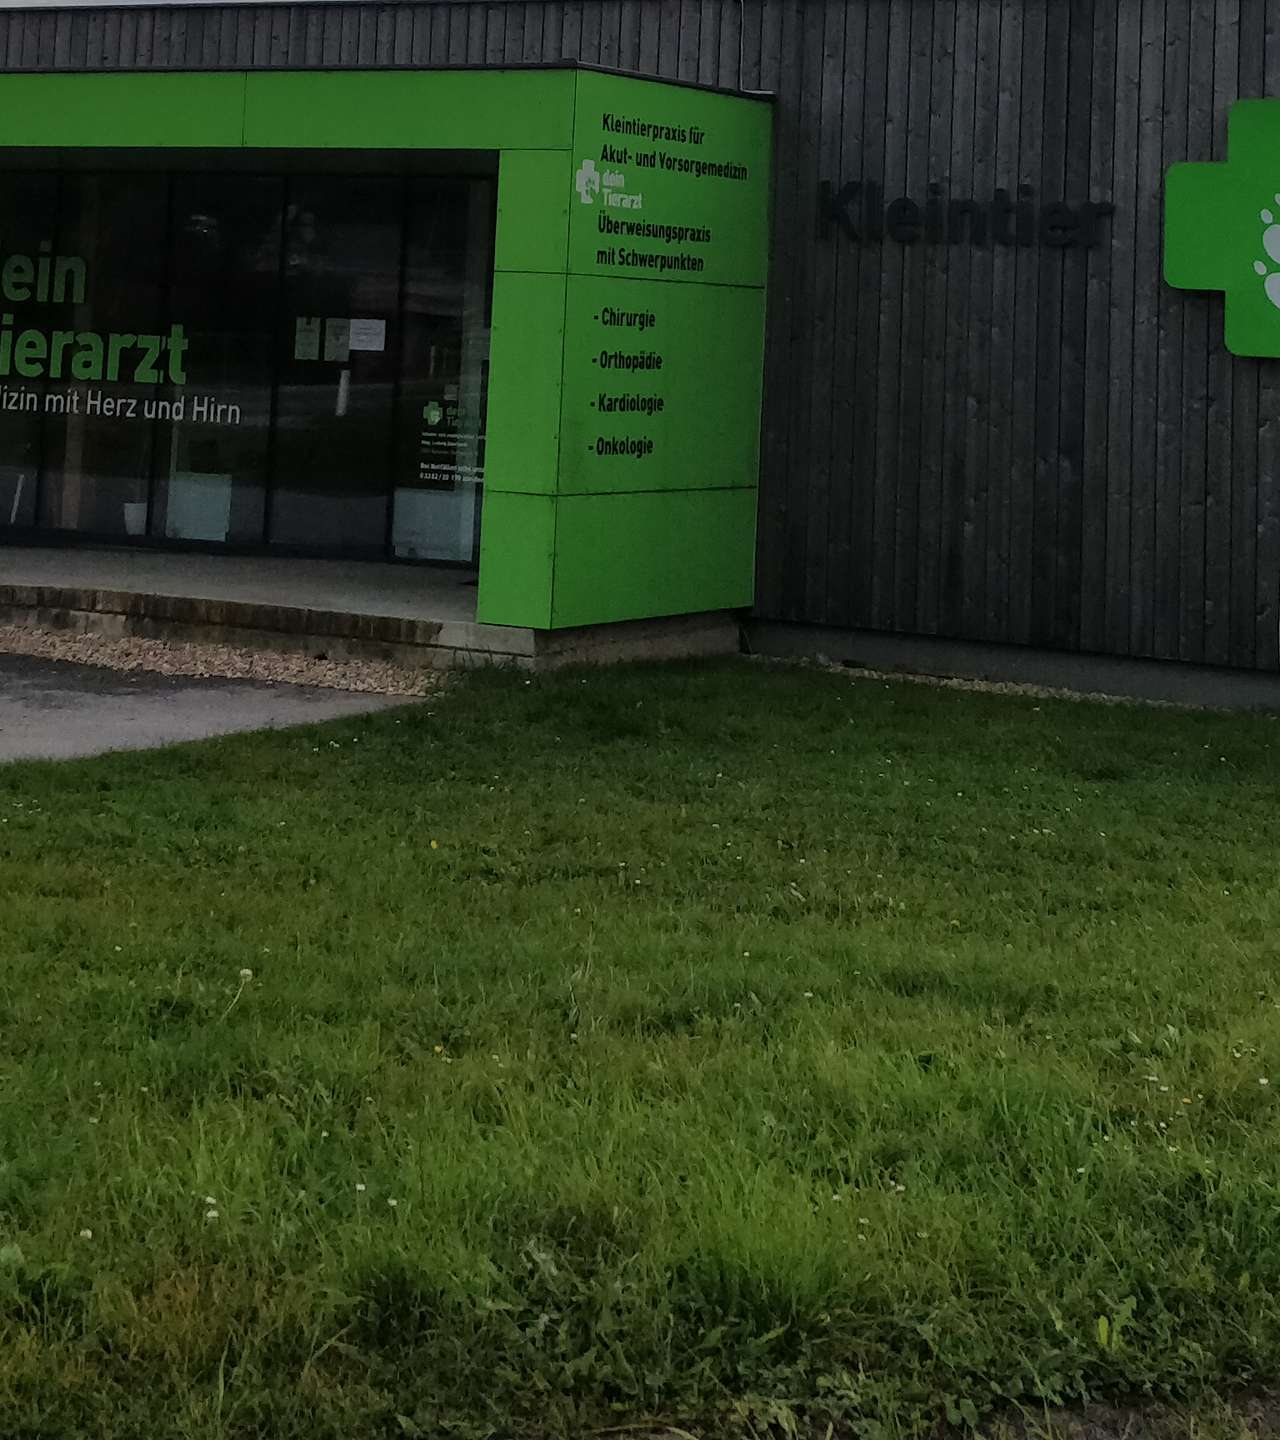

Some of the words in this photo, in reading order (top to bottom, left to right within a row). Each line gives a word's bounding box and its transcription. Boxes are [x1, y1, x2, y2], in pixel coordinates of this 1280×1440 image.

[602, 113, 687, 144] Kleintierpraxis
[689, 125, 705, 145] für
[600, 144, 633, 165] Akut-
[635, 151, 657, 169] und
[658, 152, 748, 181] Vorsorgemedizin
[602, 169, 625, 188] dein
[602, 188, 643, 209] Tierarzt
[815, 178, 1116, 248] Kleintier
[598, 209, 712, 244] Überweisungspraxis
[596, 247, 616, 266] mit
[618, 247, 704, 272] Schwerpunkten
[601, 307, 656, 332] Chirurgie
[599, 350, 663, 374] Orthopädie
[44, 389, 80, 415] mit
[85, 389, 138, 418] Herz
[143, 395, 185, 421] und
[191, 395, 241, 425] Hirn
[598, 393, 665, 417] Kardiologie
[596, 436, 654, 458] Onkologie
